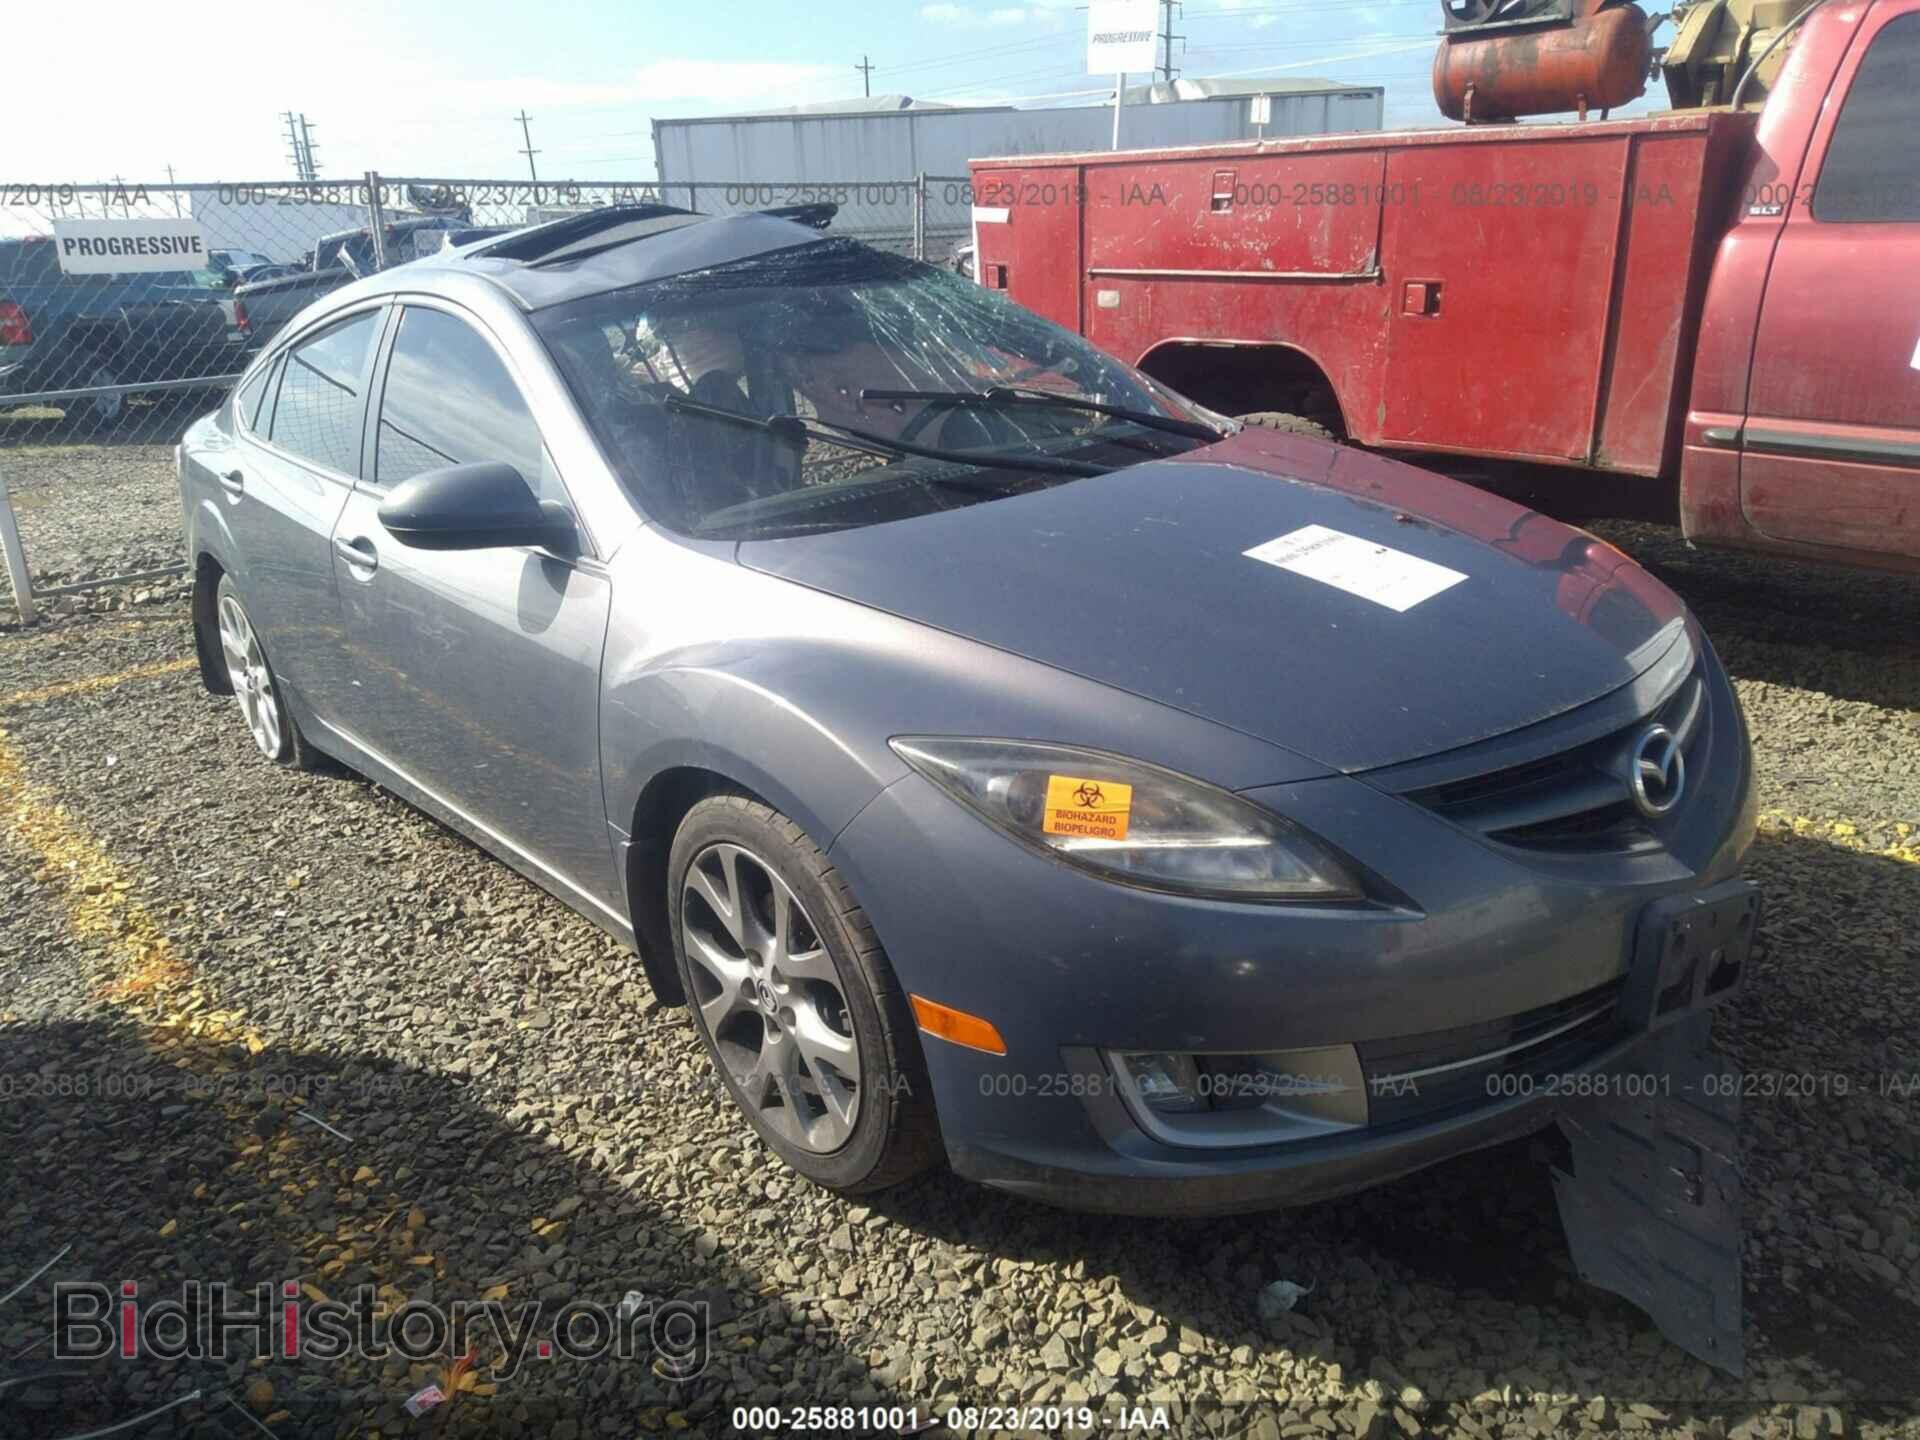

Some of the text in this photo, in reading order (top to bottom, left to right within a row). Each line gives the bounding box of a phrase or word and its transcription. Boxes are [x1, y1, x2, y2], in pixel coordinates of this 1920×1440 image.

[1750, 206, 1781, 215] SLT
[62, 236, 202, 256] PROGRESSIVE
[1055, 809, 1117, 825] BIOHAZARD
[1054, 822, 1116, 838] BIOPELIGRO
